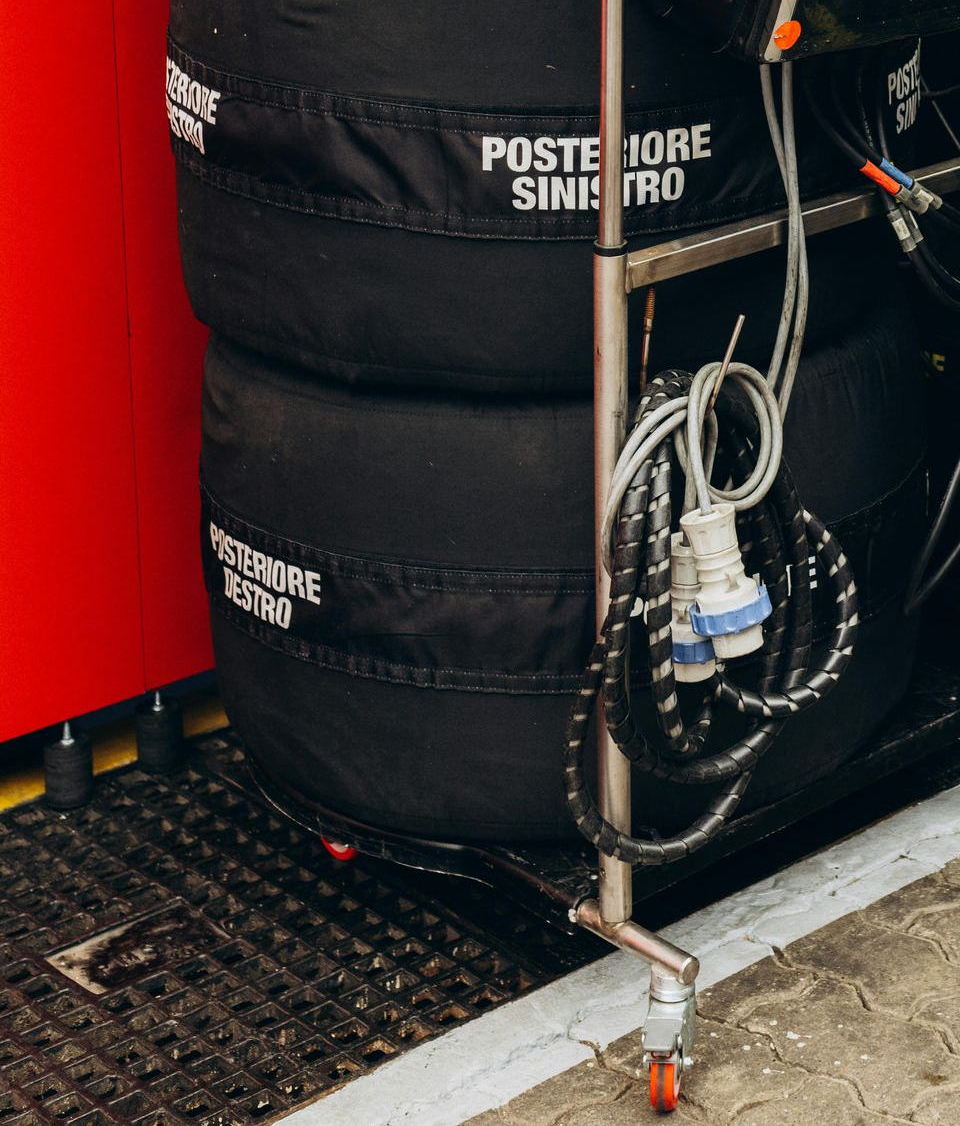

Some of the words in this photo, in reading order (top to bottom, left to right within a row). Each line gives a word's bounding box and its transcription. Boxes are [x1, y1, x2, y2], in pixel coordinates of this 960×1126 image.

[482, 123, 711, 173] POSTEIORE
[209, 521, 321, 605] POSTERIORE
[223, 566, 292, 629] DESTRO
